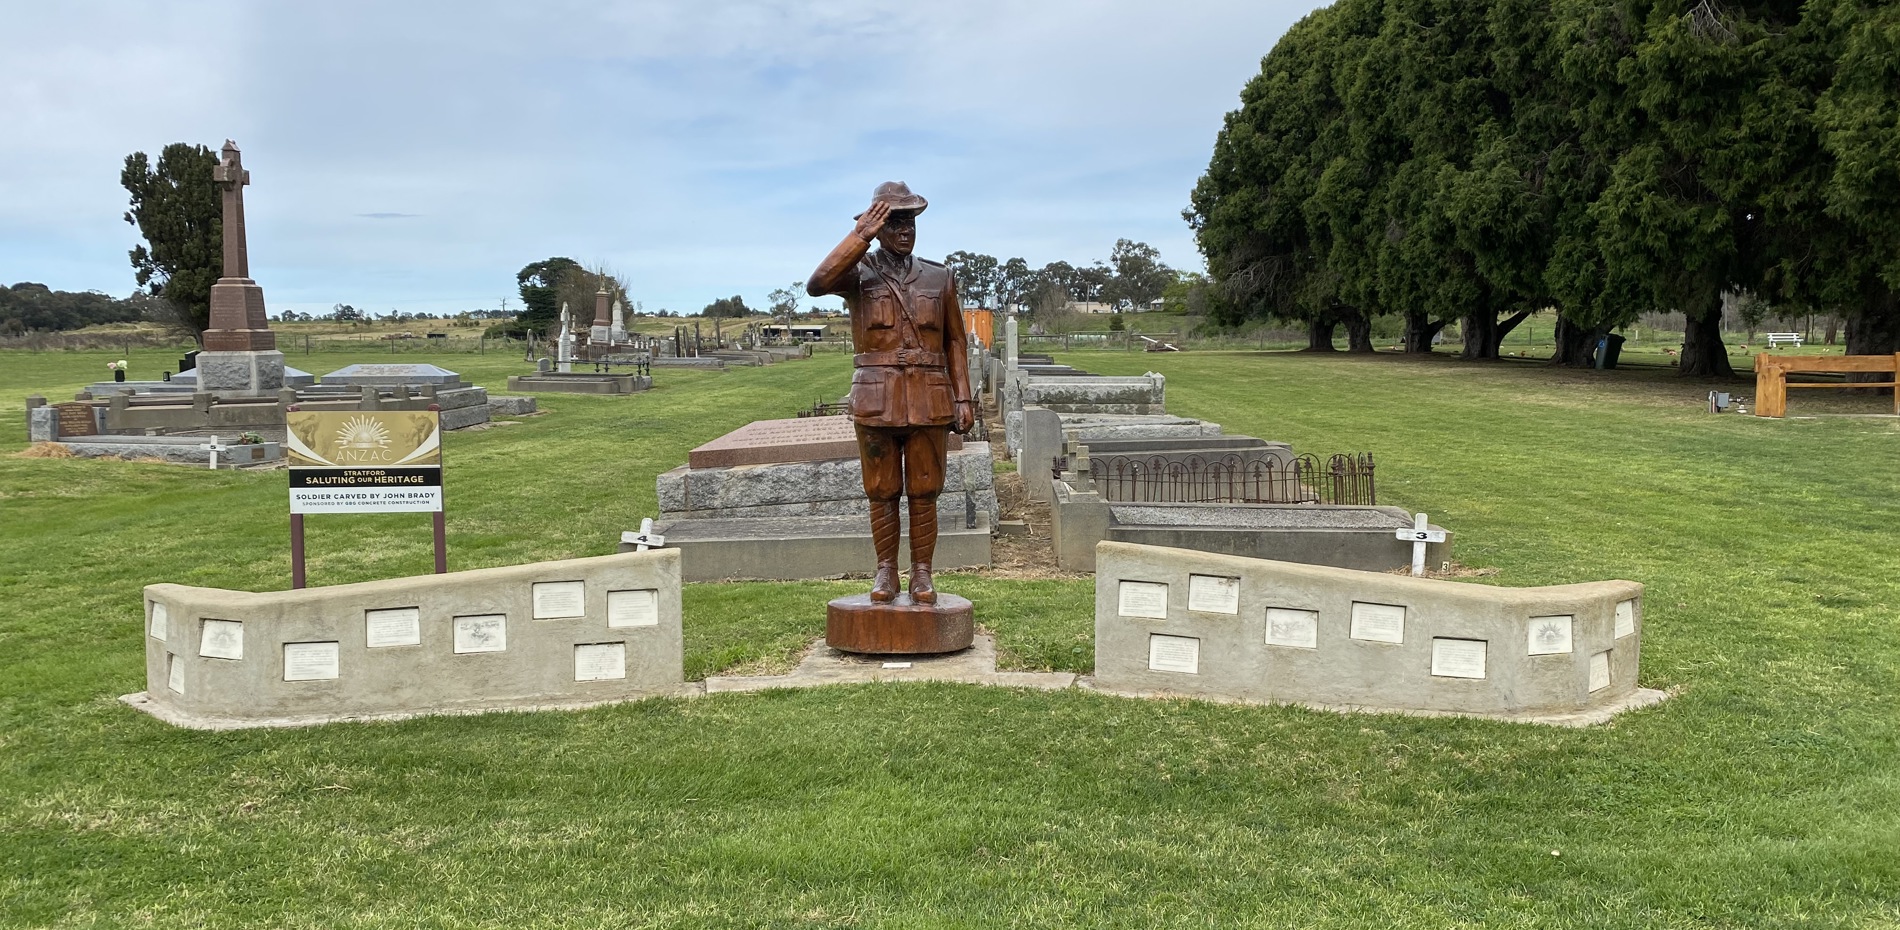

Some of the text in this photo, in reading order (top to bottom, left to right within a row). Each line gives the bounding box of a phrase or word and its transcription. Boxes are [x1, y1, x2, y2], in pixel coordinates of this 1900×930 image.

[336, 450, 392, 461] ANZAC
[305, 476, 356, 485] SALUTING
[374, 475, 424, 483] HERITAGE
